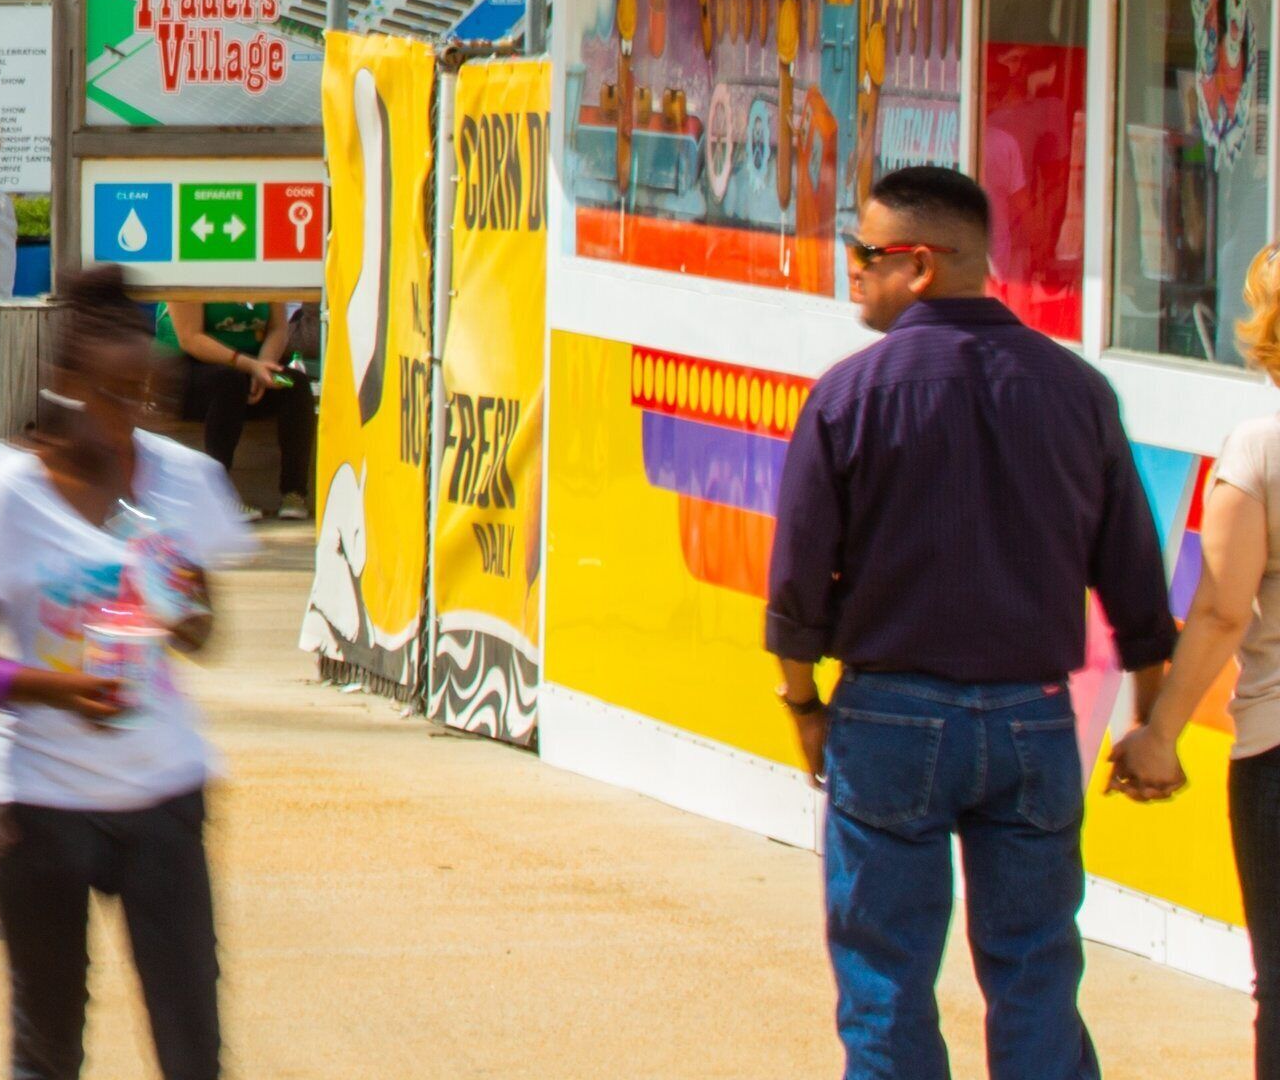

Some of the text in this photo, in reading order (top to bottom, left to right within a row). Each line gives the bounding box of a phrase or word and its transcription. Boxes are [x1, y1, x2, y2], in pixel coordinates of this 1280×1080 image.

[156, 21, 286, 94] Village
[461, 112, 522, 231] CORN
[116, 191, 148, 200] CLEAN
[194, 190, 243, 201] SEPARATE
[285, 187, 315, 198] COOK
[472, 522, 515, 578] DAILY
